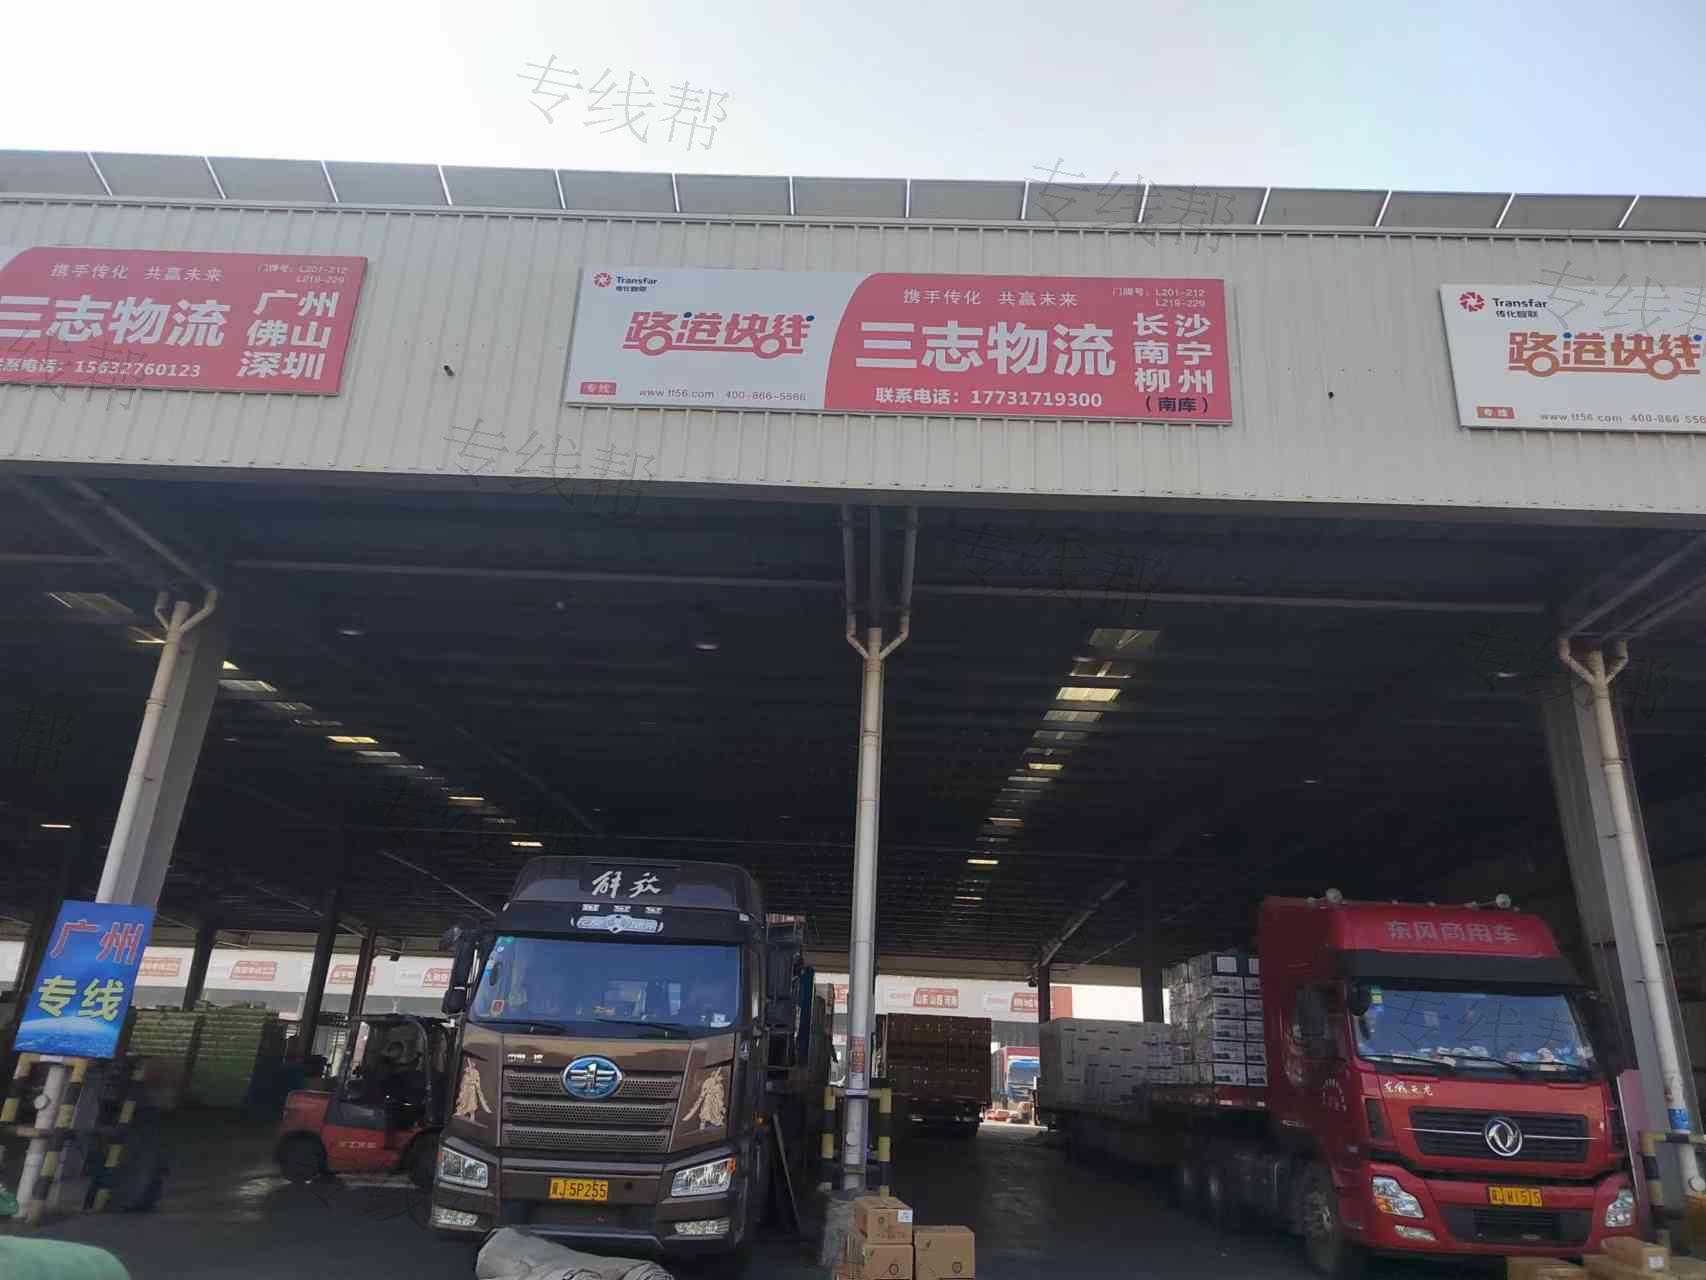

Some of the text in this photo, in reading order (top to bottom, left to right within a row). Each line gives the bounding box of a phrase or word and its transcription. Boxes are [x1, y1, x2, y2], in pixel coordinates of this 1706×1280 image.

[50, 264, 224, 283] 携手传化 共赢未来
[253, 290, 340, 318] 广州
[903, 289, 1079, 307] 携手传化 共赢未来
[1492, 298, 1548, 308] Transfar
[0, 294, 231, 347] 三志物流
[246, 319, 332, 349] 佛山
[1133, 313, 1212, 337] 长沙
[856, 320, 1116, 376] 三志物流
[1134, 340, 1213, 365] 南宁
[236, 350, 326, 380] 深圳
[1134, 367, 1214, 394] 柳州
[875, 387, 1102, 408] 联系电话： 17731719300
[51, 919, 145, 965] 广州
[1386, 920, 1520, 943] 东风商用车
[38, 976, 125, 1021] 专线
